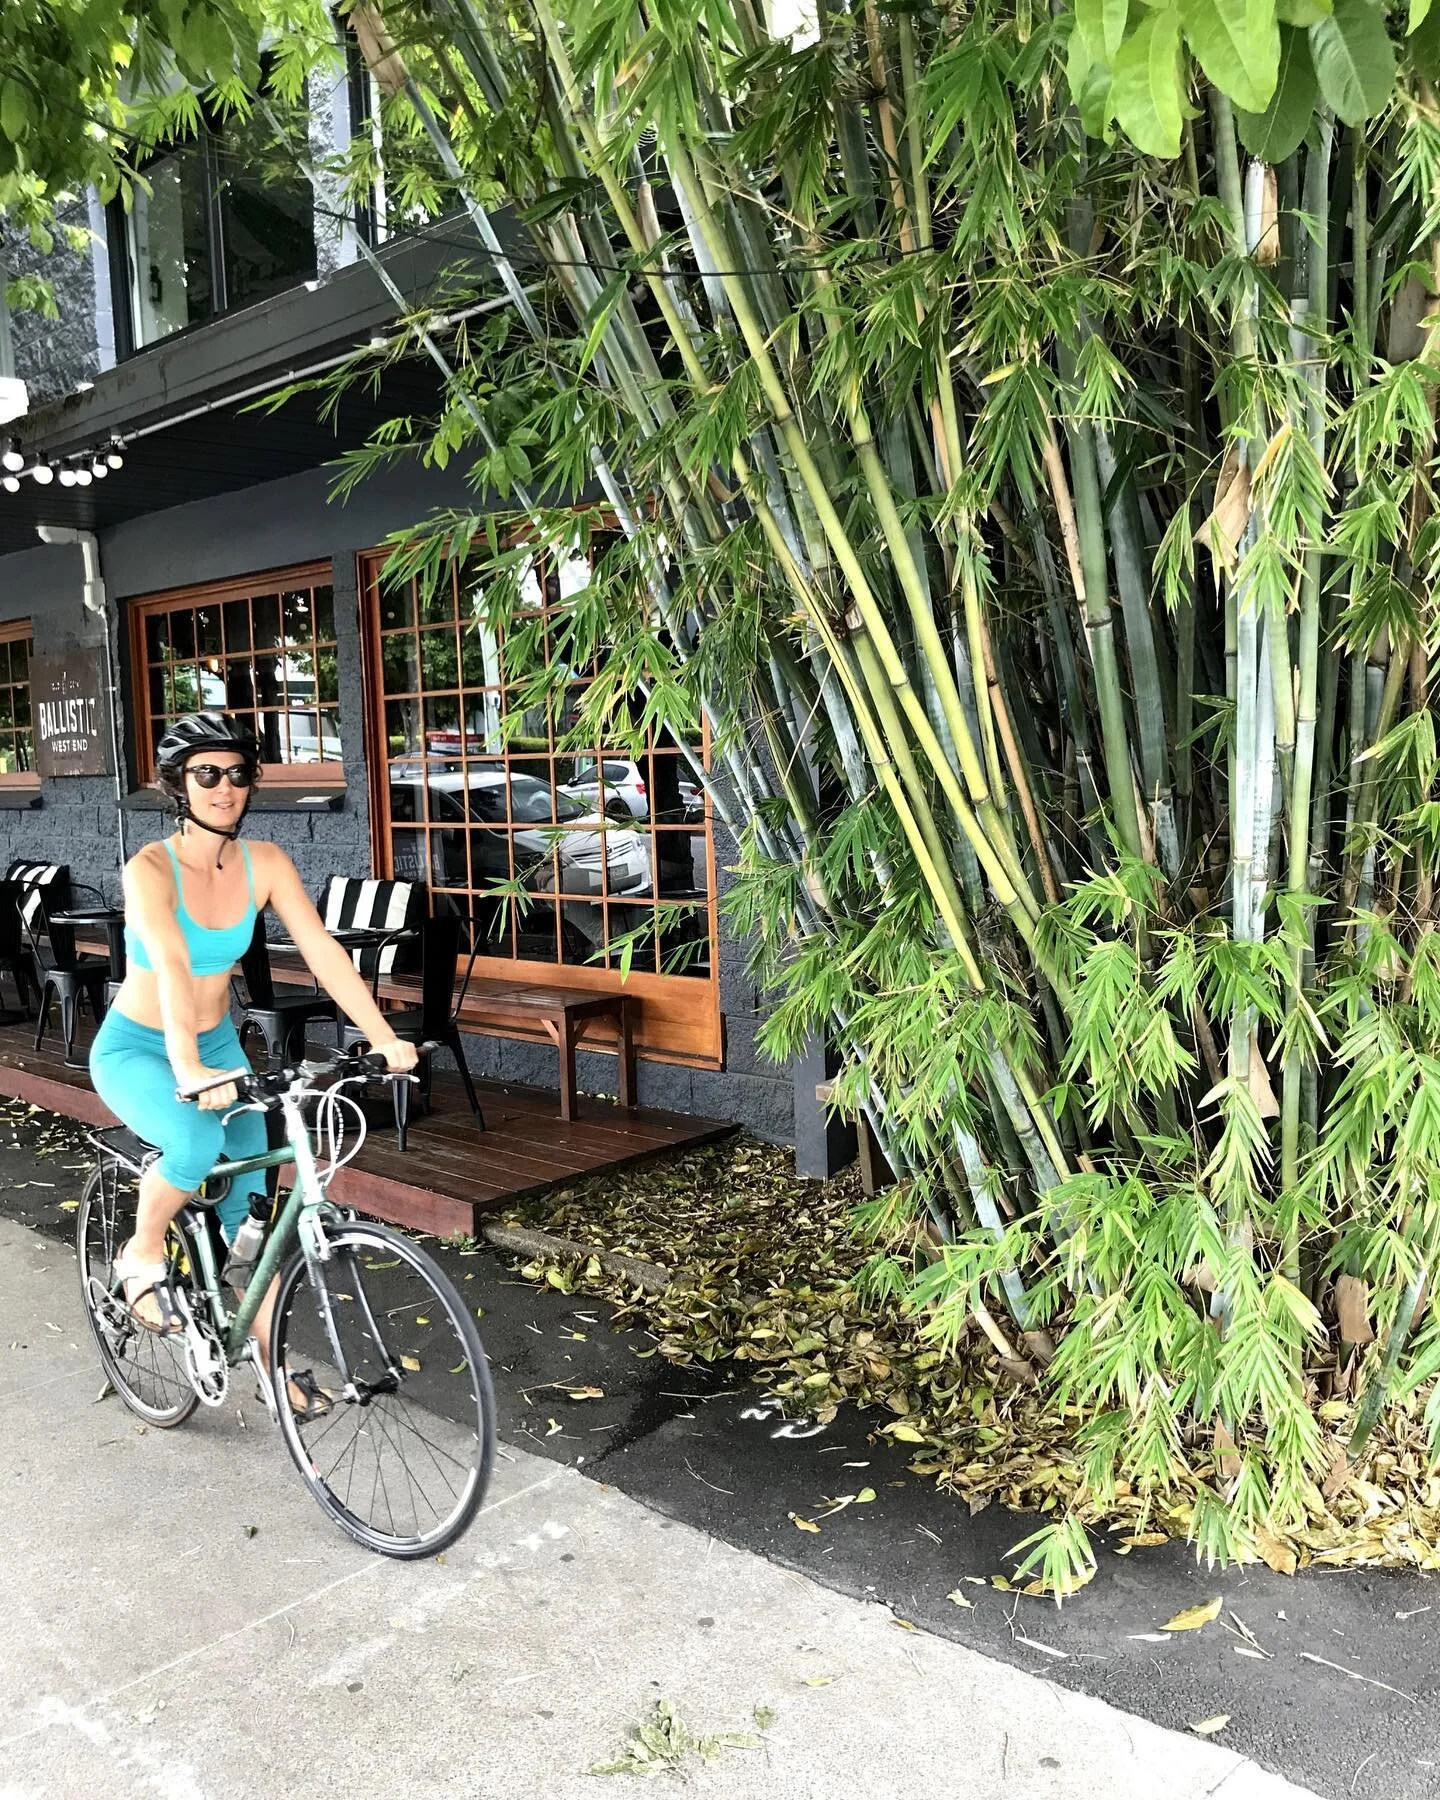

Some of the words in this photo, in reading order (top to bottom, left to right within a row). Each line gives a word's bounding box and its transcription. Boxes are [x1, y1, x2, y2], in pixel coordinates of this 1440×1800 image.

[39, 698, 97, 741] BALLISTIC
[51, 739, 70, 753] WEST
[72, 738, 88, 752] END
